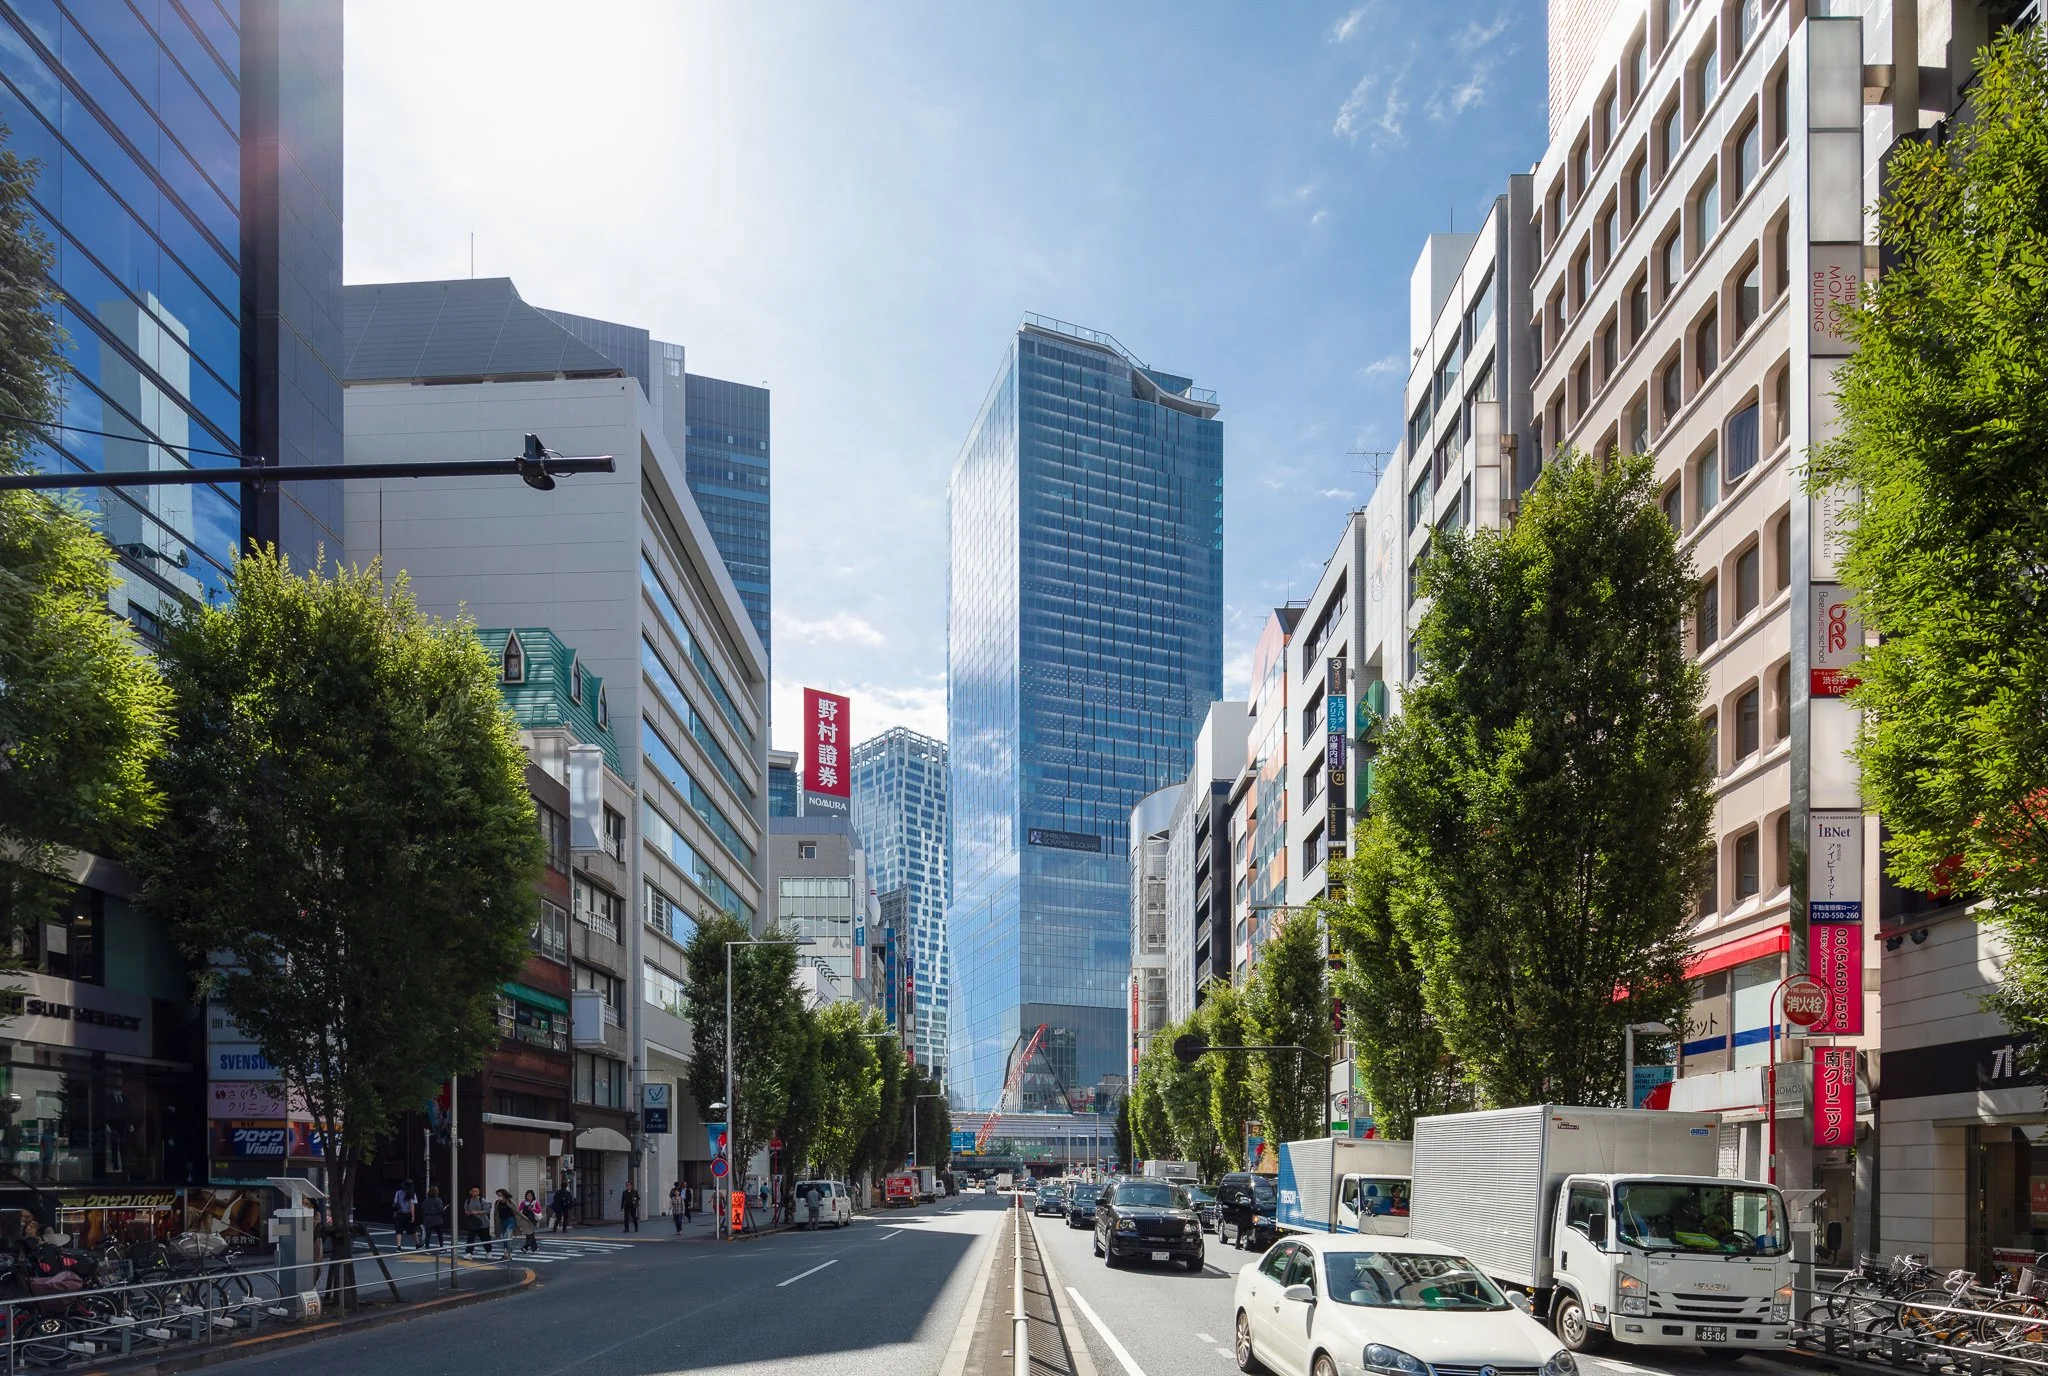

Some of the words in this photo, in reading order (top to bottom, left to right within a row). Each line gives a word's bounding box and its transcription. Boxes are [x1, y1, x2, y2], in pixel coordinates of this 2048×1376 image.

[1813, 271, 1825, 332] BUILDING
[1823, 495, 1831, 518] NAIL
[1827, 685, 1844, 693] 10F
[817, 697, 839, 788] 野村證券
[1329, 734, 1338, 766] 心療内科
[808, 796, 847, 811] NOMURA
[1043, 831, 1070, 841] SHIBUYA
[1834, 928, 1849, 1030] 03(5468)7595
[1786, 995, 1823, 1013] 消火栓
[1843, 1051, 1853, 1085] 美容外科
[1824, 1051, 1842, 1143] 南クリニック
[228, 1102, 280, 1113] クリニック
[233, 1129, 285, 1142] クロサワ
[245, 1142, 285, 1155] Violin
[86, 1194, 178, 1207] クロサワバイオリン
